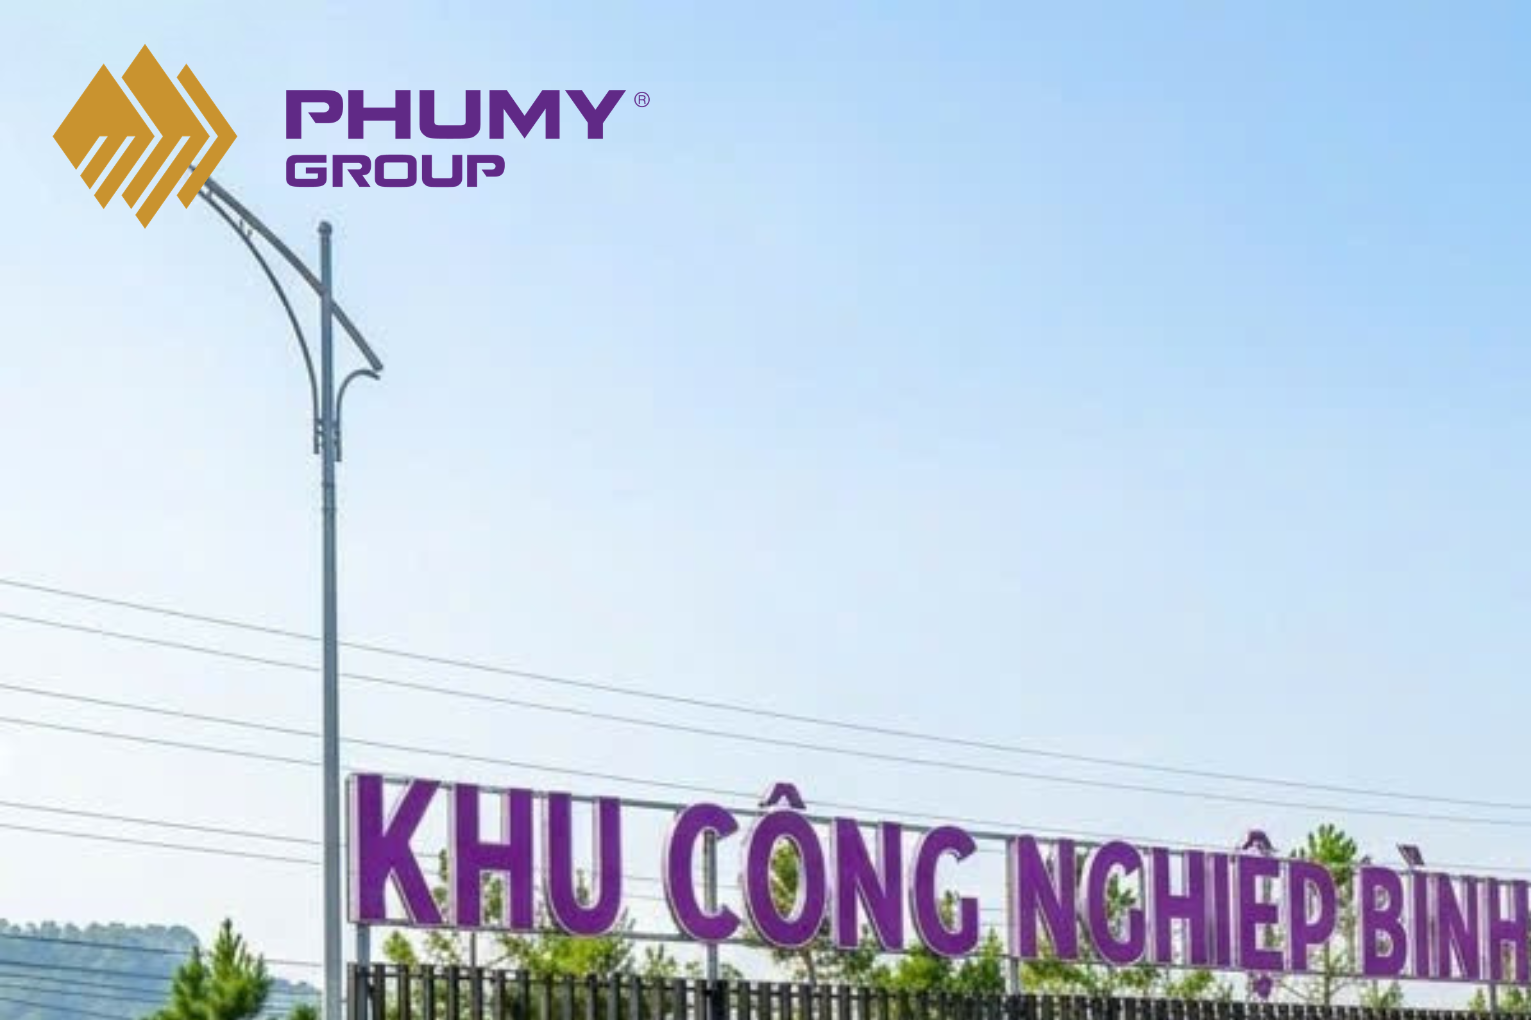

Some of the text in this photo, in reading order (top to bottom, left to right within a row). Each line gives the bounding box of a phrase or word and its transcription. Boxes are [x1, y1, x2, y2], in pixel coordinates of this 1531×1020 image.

[350, 773, 623, 936] KHU
[664, 782, 979, 958] CÔNG
[1012, 829, 1337, 998] NGHIỆP
[1358, 843, 1530, 983] BÌNH
